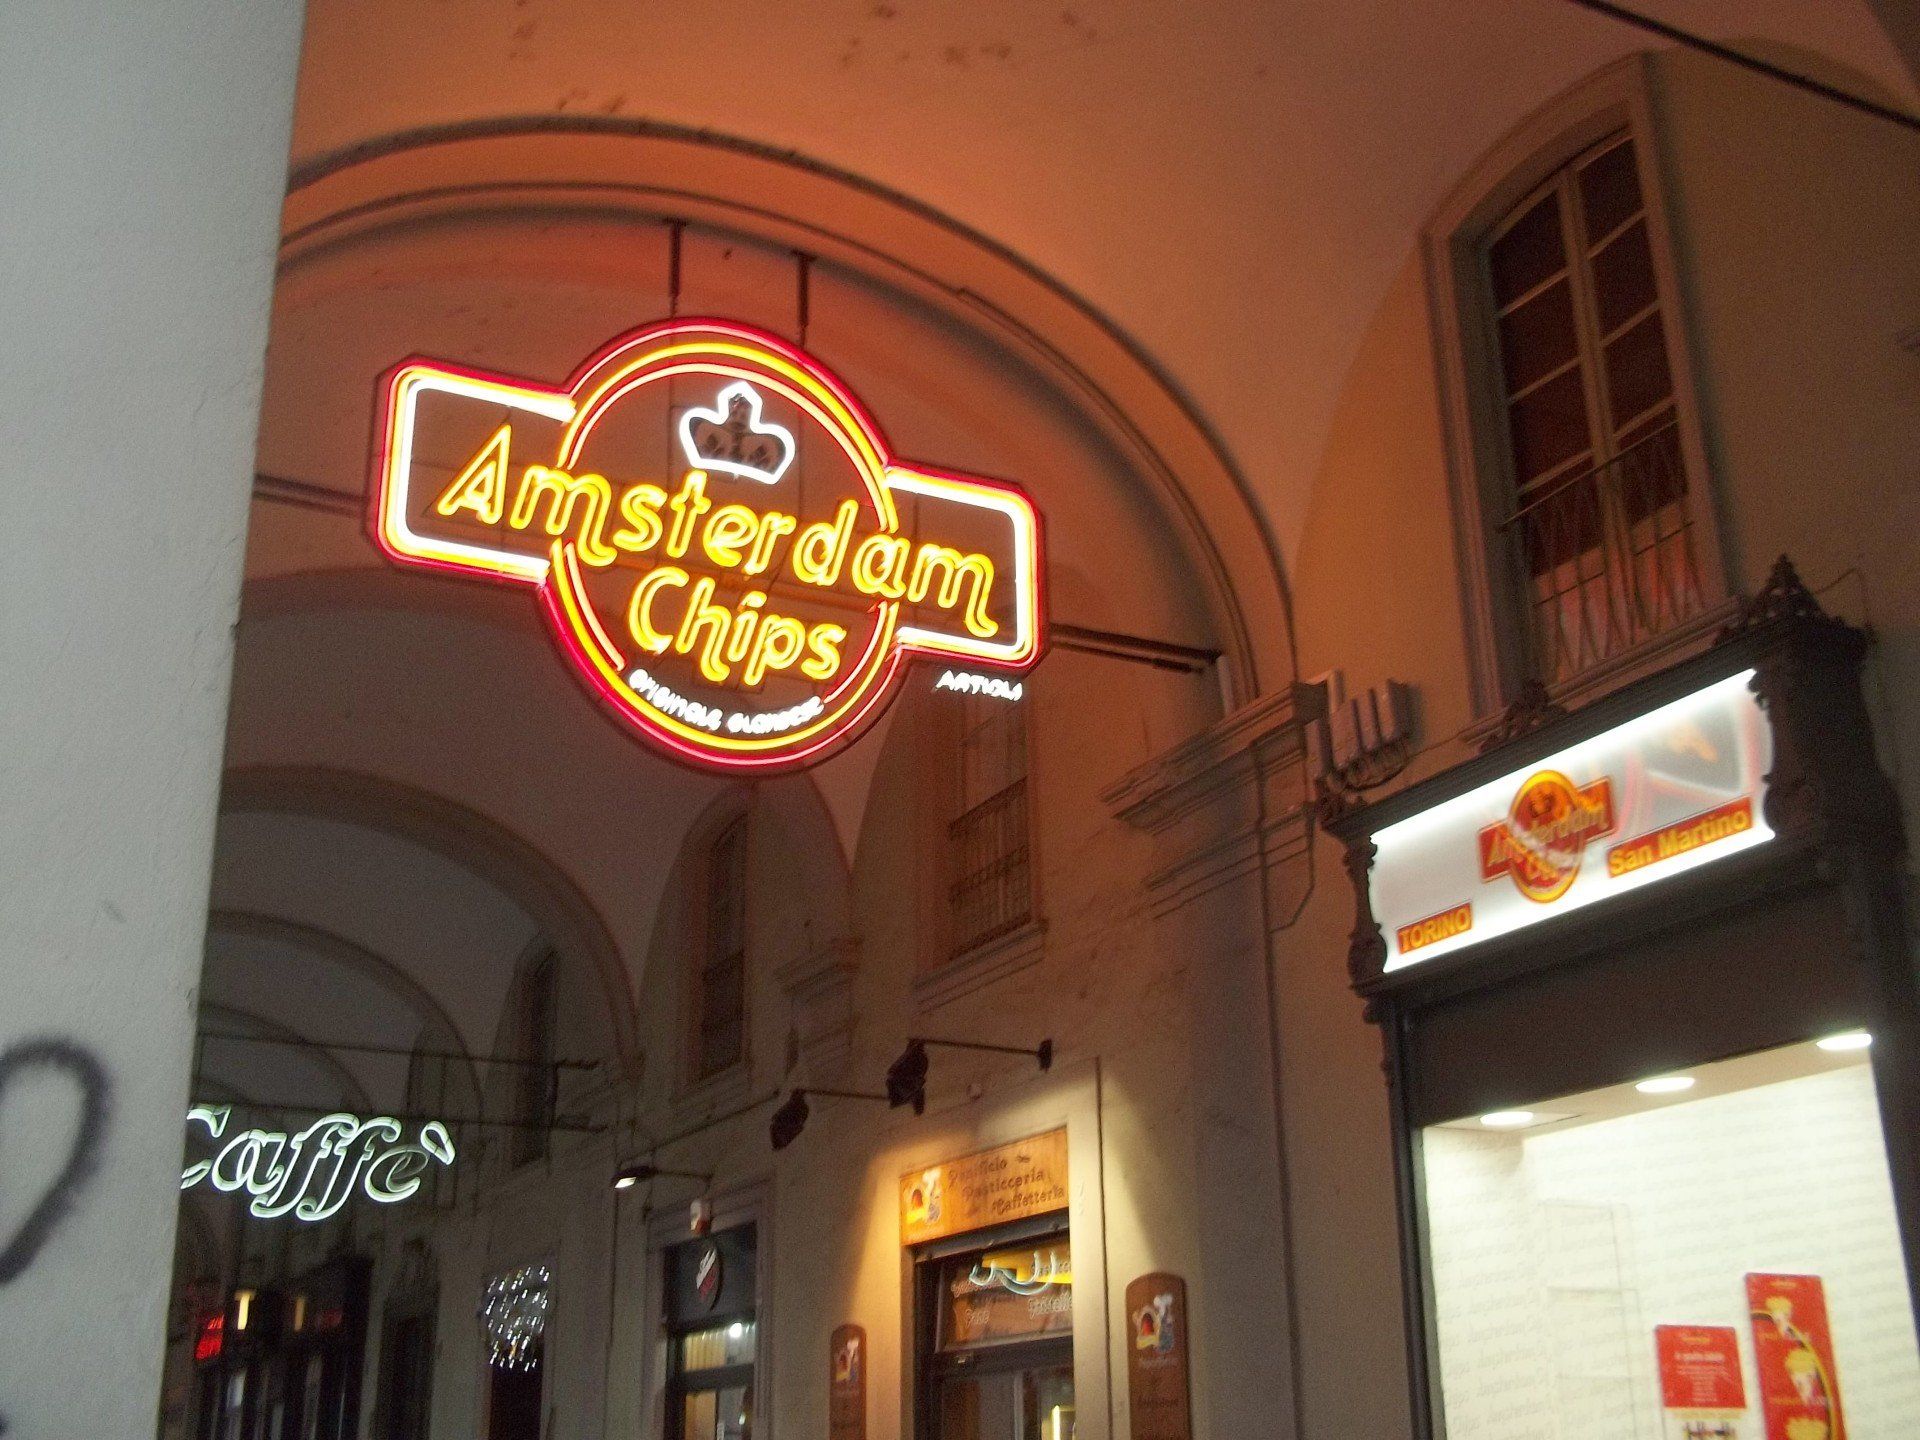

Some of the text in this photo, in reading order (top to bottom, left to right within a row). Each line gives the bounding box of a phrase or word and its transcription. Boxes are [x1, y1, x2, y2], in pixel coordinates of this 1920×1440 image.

[436, 424, 999, 638] Amsterdam
[627, 565, 847, 688] Chips
[1609, 844, 1652, 876] San
[1659, 810, 1749, 861] Martino
[1400, 907, 1472, 951] TORINO
